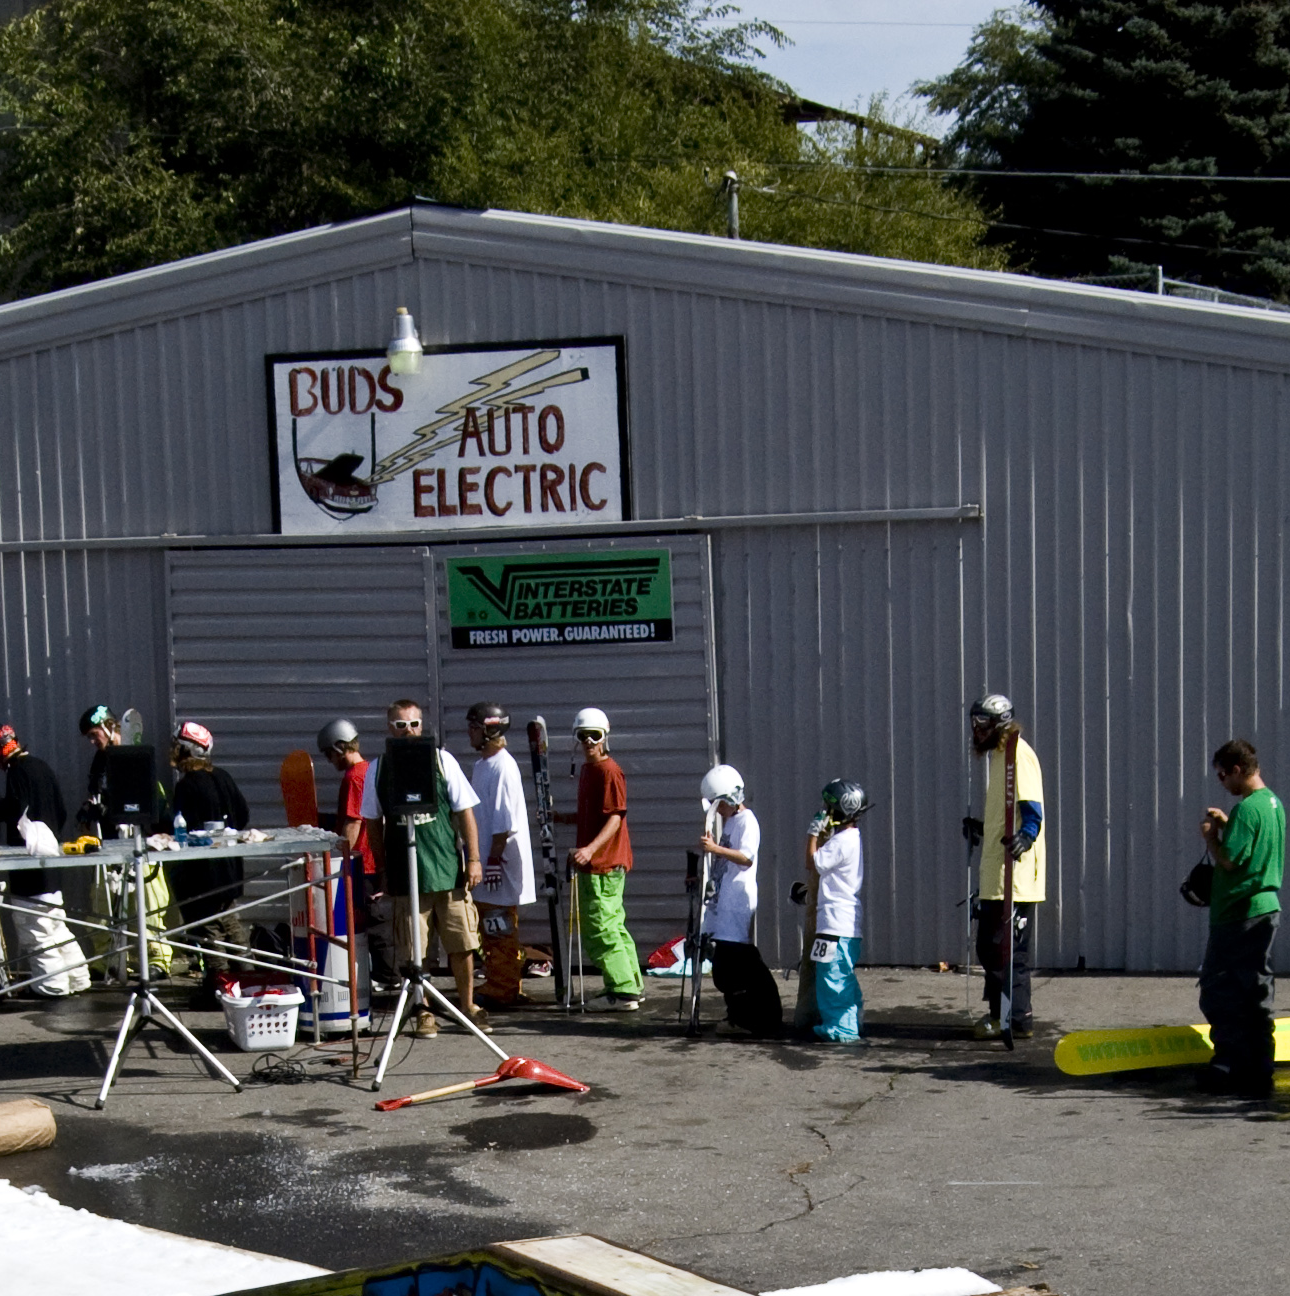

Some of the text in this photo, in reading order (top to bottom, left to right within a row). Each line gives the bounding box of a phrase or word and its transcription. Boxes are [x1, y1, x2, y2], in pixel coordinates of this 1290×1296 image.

[289, 365, 404, 418] BUDS
[458, 404, 566, 458] AUTO
[412, 462, 608, 518] ELECTRIC
[517, 576, 653, 600] INTERSTATE
[513, 597, 639, 621] BATTERIES
[469, 630, 508, 645] FRESH
[564, 622, 656, 642] GUARANTEED!
[485, 917, 502, 933] 21
[813, 941, 828, 958] 28
